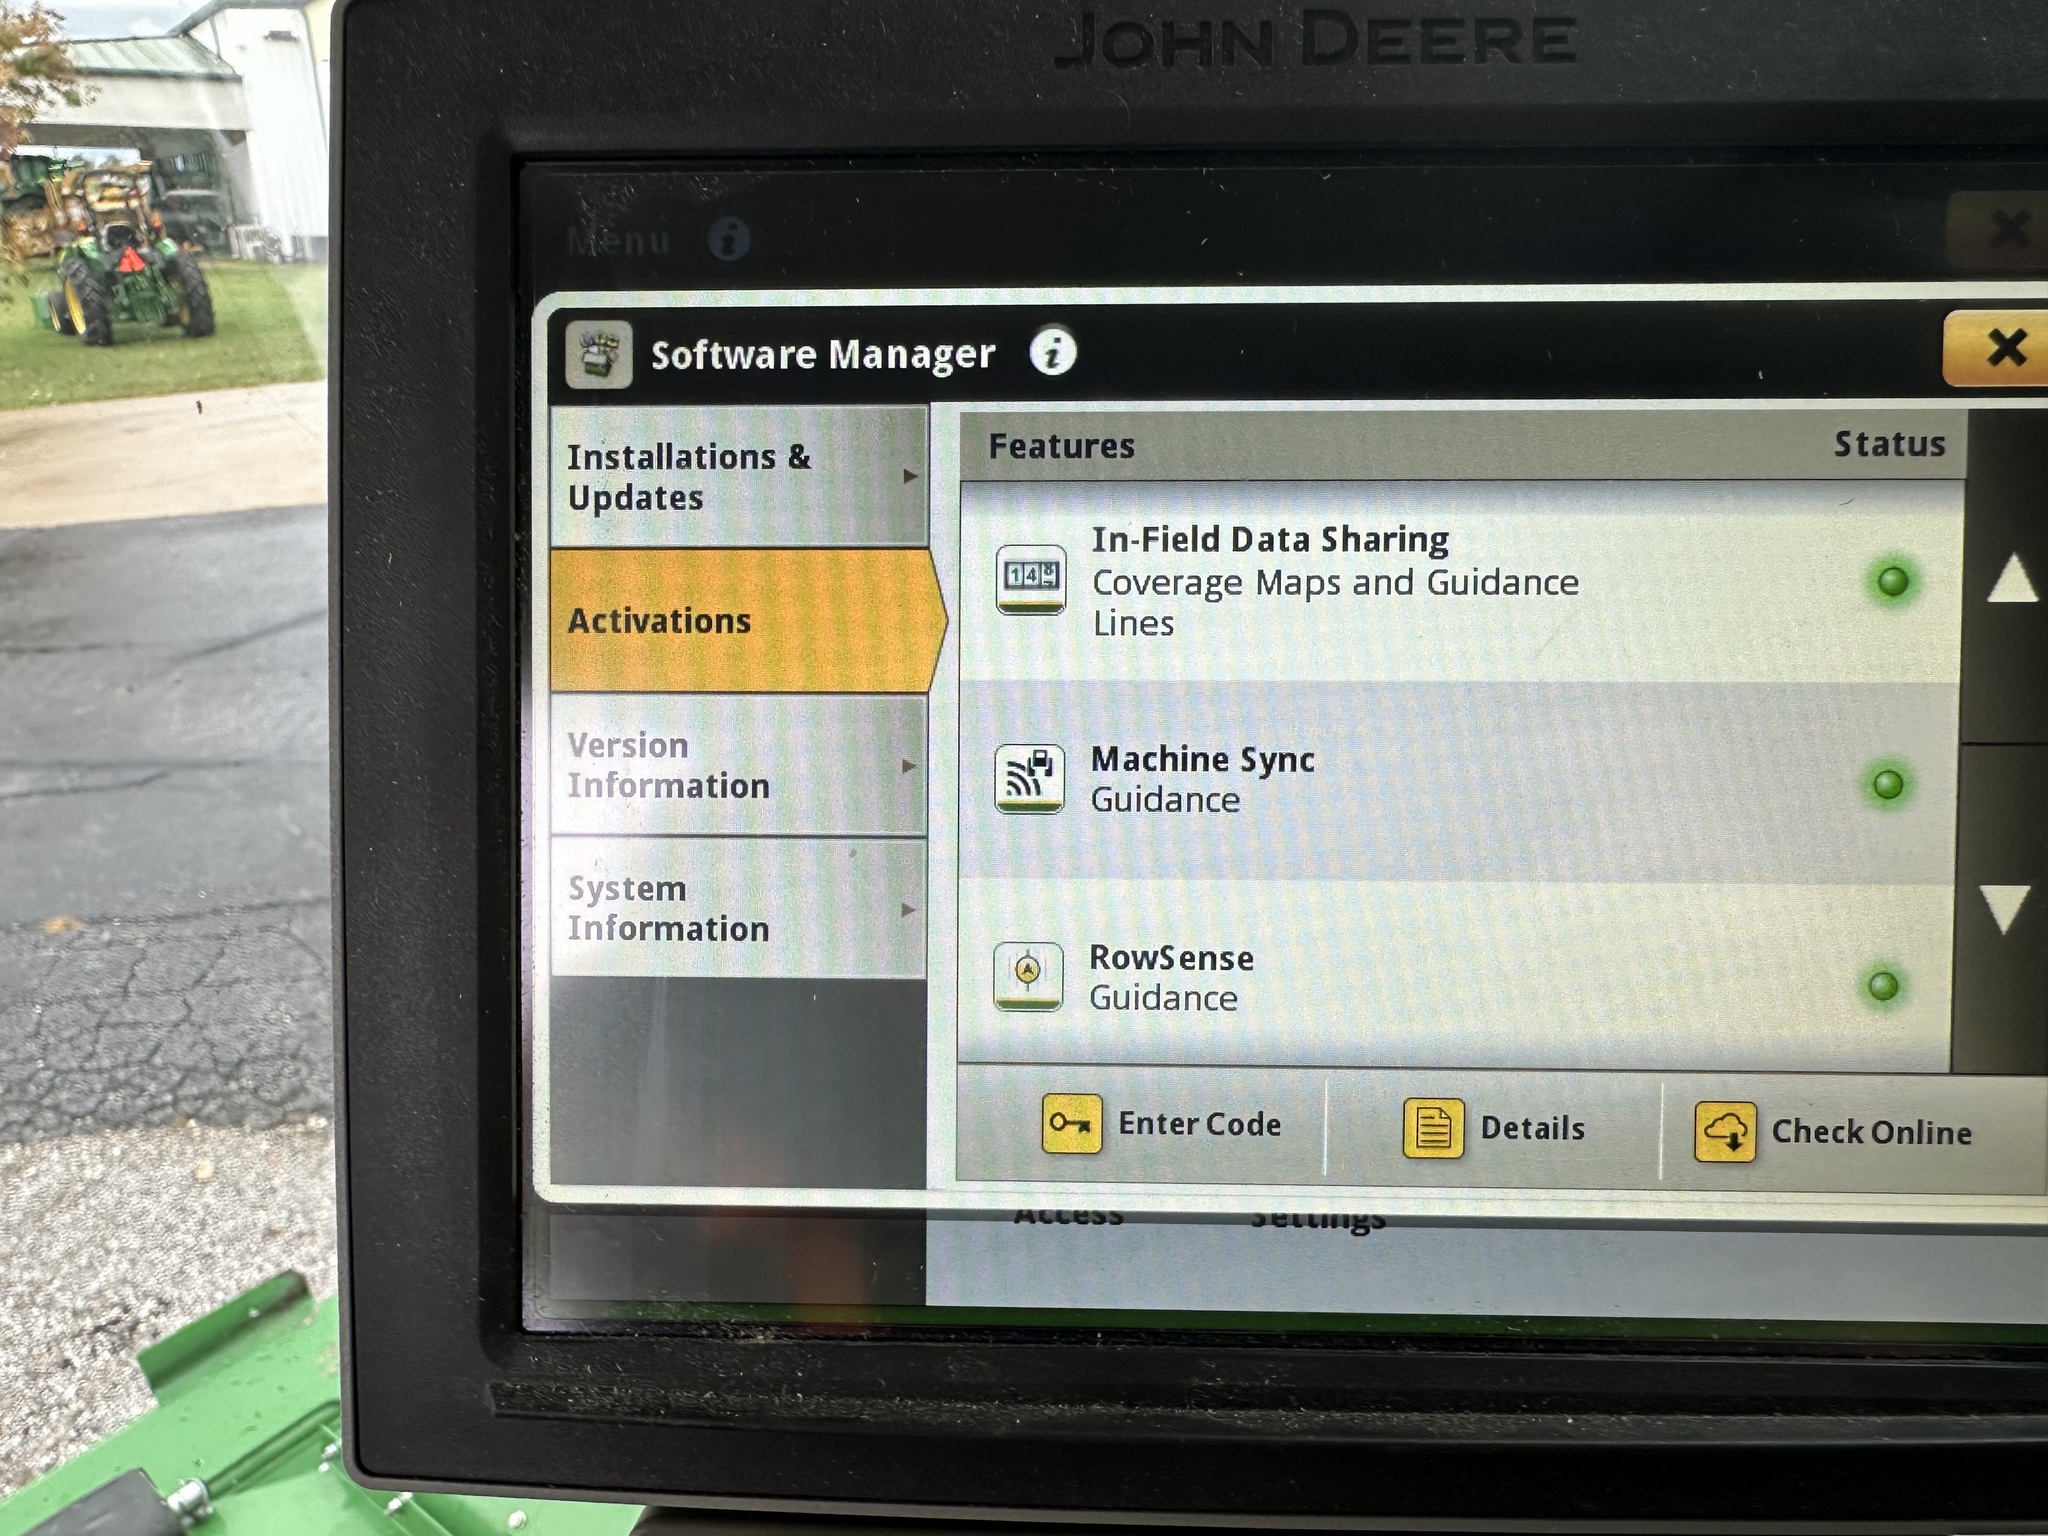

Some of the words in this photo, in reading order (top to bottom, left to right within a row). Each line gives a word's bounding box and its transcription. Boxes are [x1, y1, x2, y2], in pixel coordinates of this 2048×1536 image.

[1055, 11, 1273, 68] JOHN
[1303, 9, 1578, 65] DEERE
[568, 225, 671, 256] Menu
[653, 338, 817, 369] Software
[830, 339, 996, 378] Manager
[568, 442, 775, 470] Installations
[789, 444, 811, 469] &
[991, 433, 1134, 459] Features
[1834, 430, 1946, 456] Status
[570, 483, 703, 517] Updates
[1093, 525, 1219, 552] In-Field
[1233, 527, 1309, 552] Data
[1322, 525, 1449, 559] Sharing
[1094, 569, 1242, 603] Coverage
[1258, 570, 1340, 602] Maps
[1354, 568, 1413, 595] and
[1428, 568, 1578, 595] Guidance
[568, 606, 750, 633] Activations
[1096, 608, 1173, 636] Lines
[568, 730, 688, 758] Version
[1093, 744, 1228, 771] Machine
[1242, 747, 1314, 780] Sync
[567, 771, 770, 798] Information
[1092, 785, 1240, 812] Guidance
[569, 874, 686, 905] System
[567, 914, 770, 941] Information
[1091, 945, 1253, 970] RowSense
[1091, 983, 1237, 1011] Guidance
[1120, 1111, 1198, 1135] Enter
[1207, 1111, 1280, 1136] Code
[1483, 1115, 1584, 1140] Details
[1773, 1118, 1863, 1143] Check
[1872, 1119, 1971, 1145] Online
